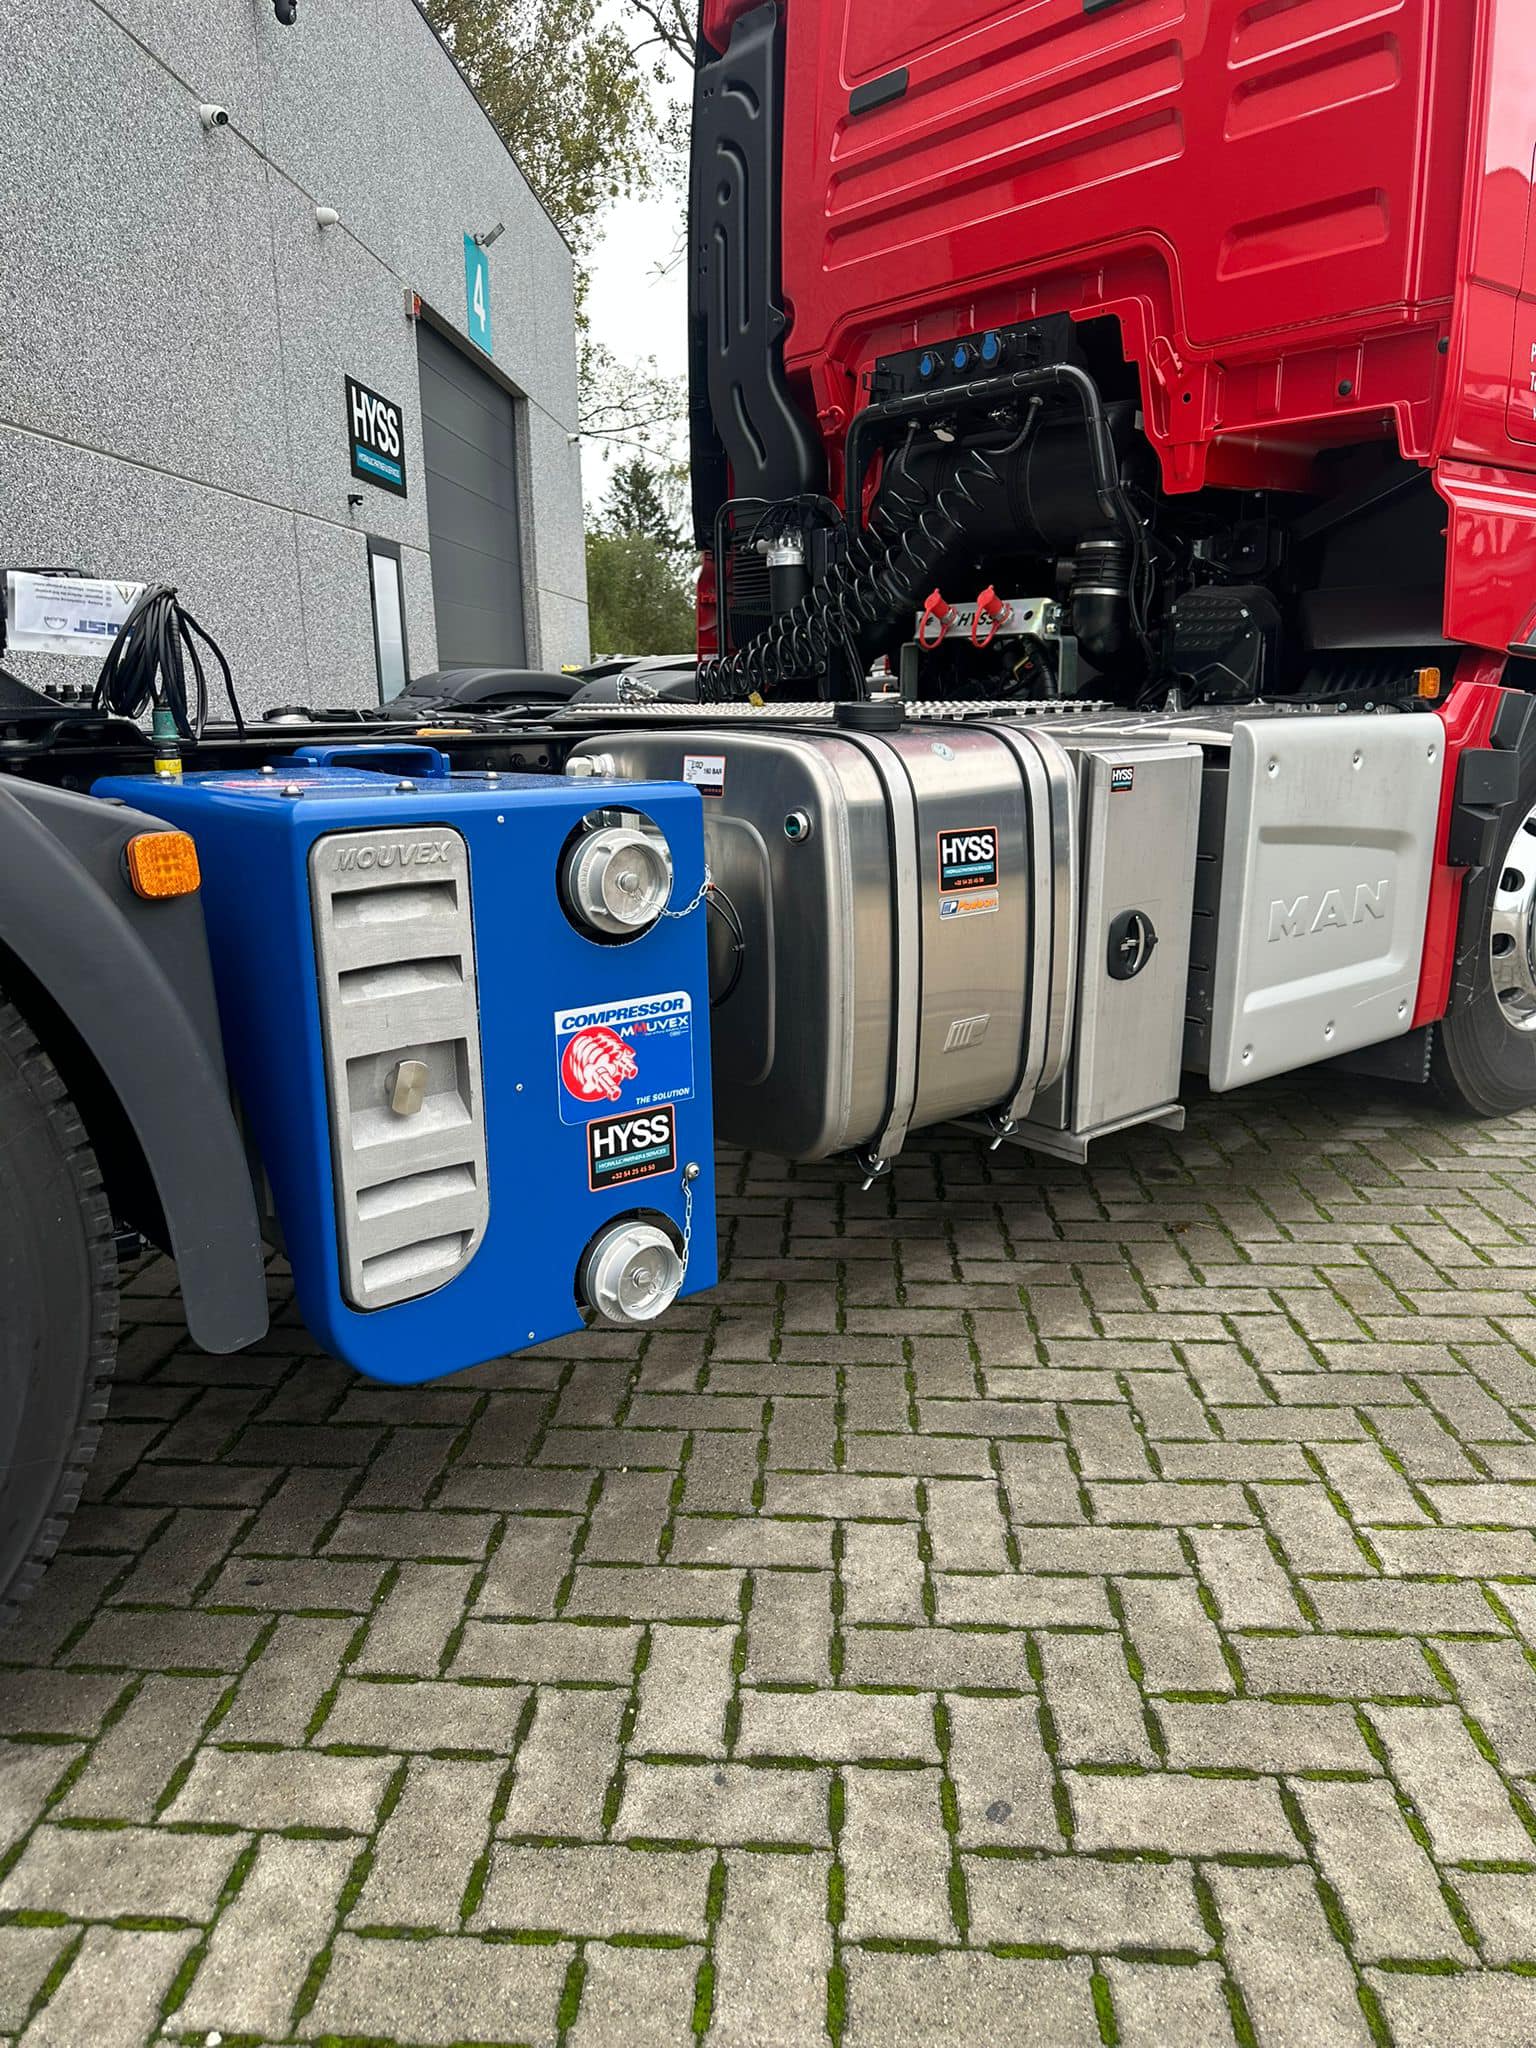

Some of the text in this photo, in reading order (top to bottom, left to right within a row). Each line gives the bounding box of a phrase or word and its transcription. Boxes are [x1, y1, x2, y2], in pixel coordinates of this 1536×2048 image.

[474, 263, 487, 333] 4
[351, 385, 400, 458] HYSS
[1112, 768, 1133, 781] HYSS
[333, 840, 451, 872] MOUVEX
[942, 834, 995, 865] HYSS
[1267, 879, 1390, 943] MAN
[561, 998, 685, 1031] COMPRESSOR
[635, 1087, 690, 1105] THE SOLUTION
[593, 1114, 670, 1158] HYSS
